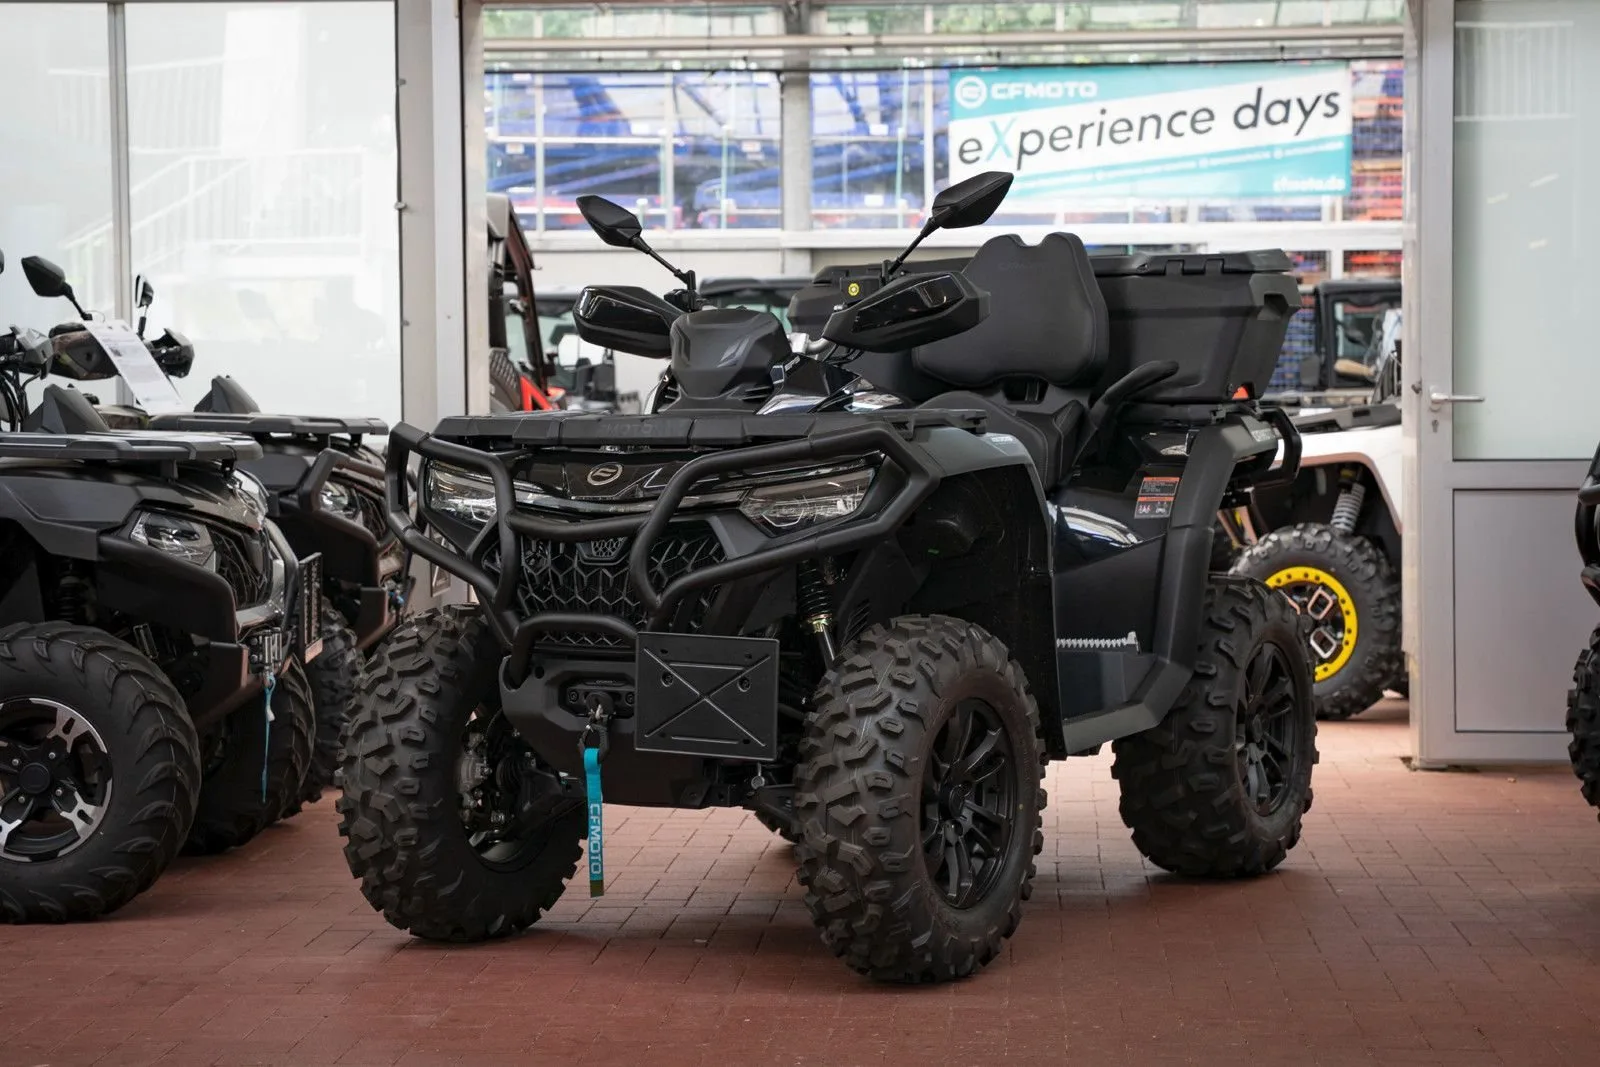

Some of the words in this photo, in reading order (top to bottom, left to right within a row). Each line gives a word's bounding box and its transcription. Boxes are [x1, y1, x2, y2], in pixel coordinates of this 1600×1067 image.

[991, 80, 1098, 101] CFMOTO
[958, 107, 1215, 170] eXperience
[1233, 86, 1340, 136] days
[589, 803, 602, 875] CFMOTO
